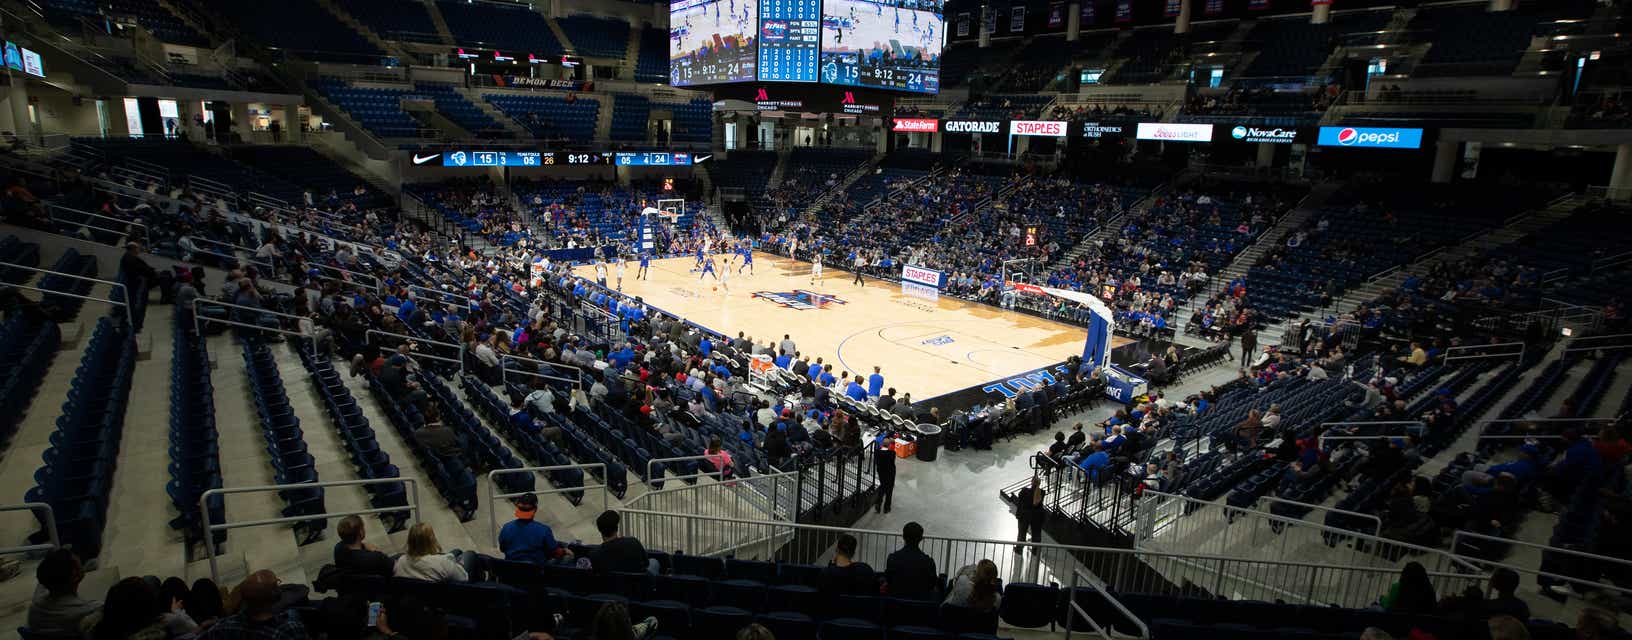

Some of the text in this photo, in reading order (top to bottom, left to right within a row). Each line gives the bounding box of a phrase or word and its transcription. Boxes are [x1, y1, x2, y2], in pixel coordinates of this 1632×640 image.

[684, 67, 692, 78] 15
[703, 65, 716, 74] 9:12
[728, 63, 739, 75] 24
[845, 66, 858, 78] 15
[875, 69, 893, 79] 9:12
[512, 77, 546, 86] DEMON
[908, 74, 921, 84] 24
[945, 122, 999, 132] GATORADE
[1016, 123, 1060, 134] STAPLES
[1247, 128, 1296, 138] NovaCare
[1358, 131, 1399, 144] pepsi
[480, 154, 492, 164] 15
[524, 157, 535, 165] 05
[568, 154, 589, 163] 9:12
[906, 268, 936, 283] STAPLES
